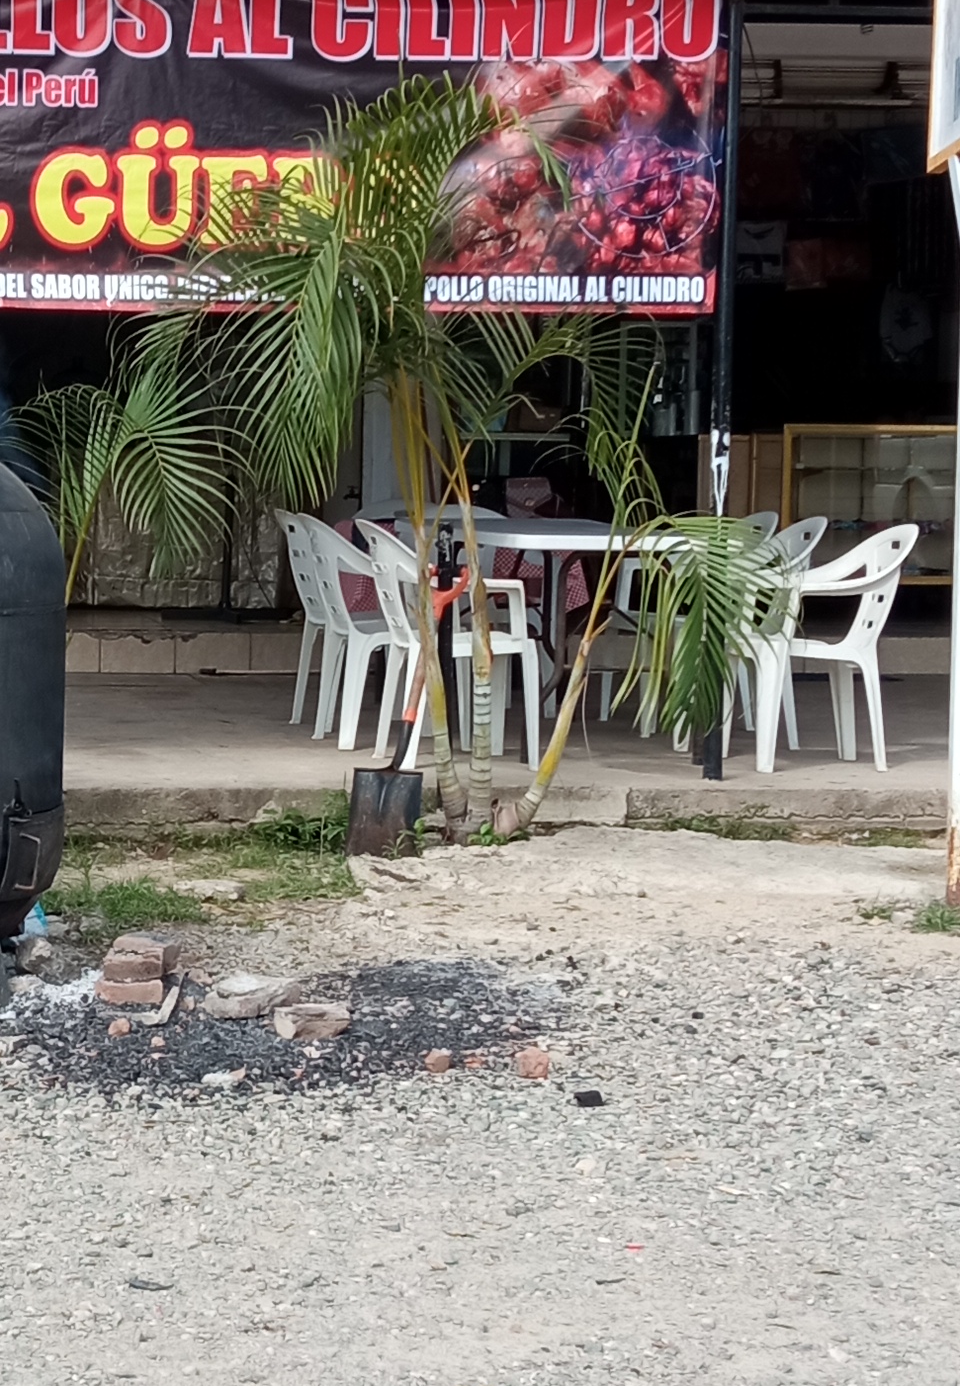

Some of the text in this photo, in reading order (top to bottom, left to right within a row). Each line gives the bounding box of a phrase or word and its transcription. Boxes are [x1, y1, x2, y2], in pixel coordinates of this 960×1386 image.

[22, 67, 99, 108] Perú
[32, 119, 426, 252] GÜER
[31, 274, 100, 299] SABOR
[424, 275, 484, 302] POLLO
[488, 275, 582, 302] ORIGINAL
[584, 276, 608, 302] AL
[611, 276, 705, 302] CILINDRO
